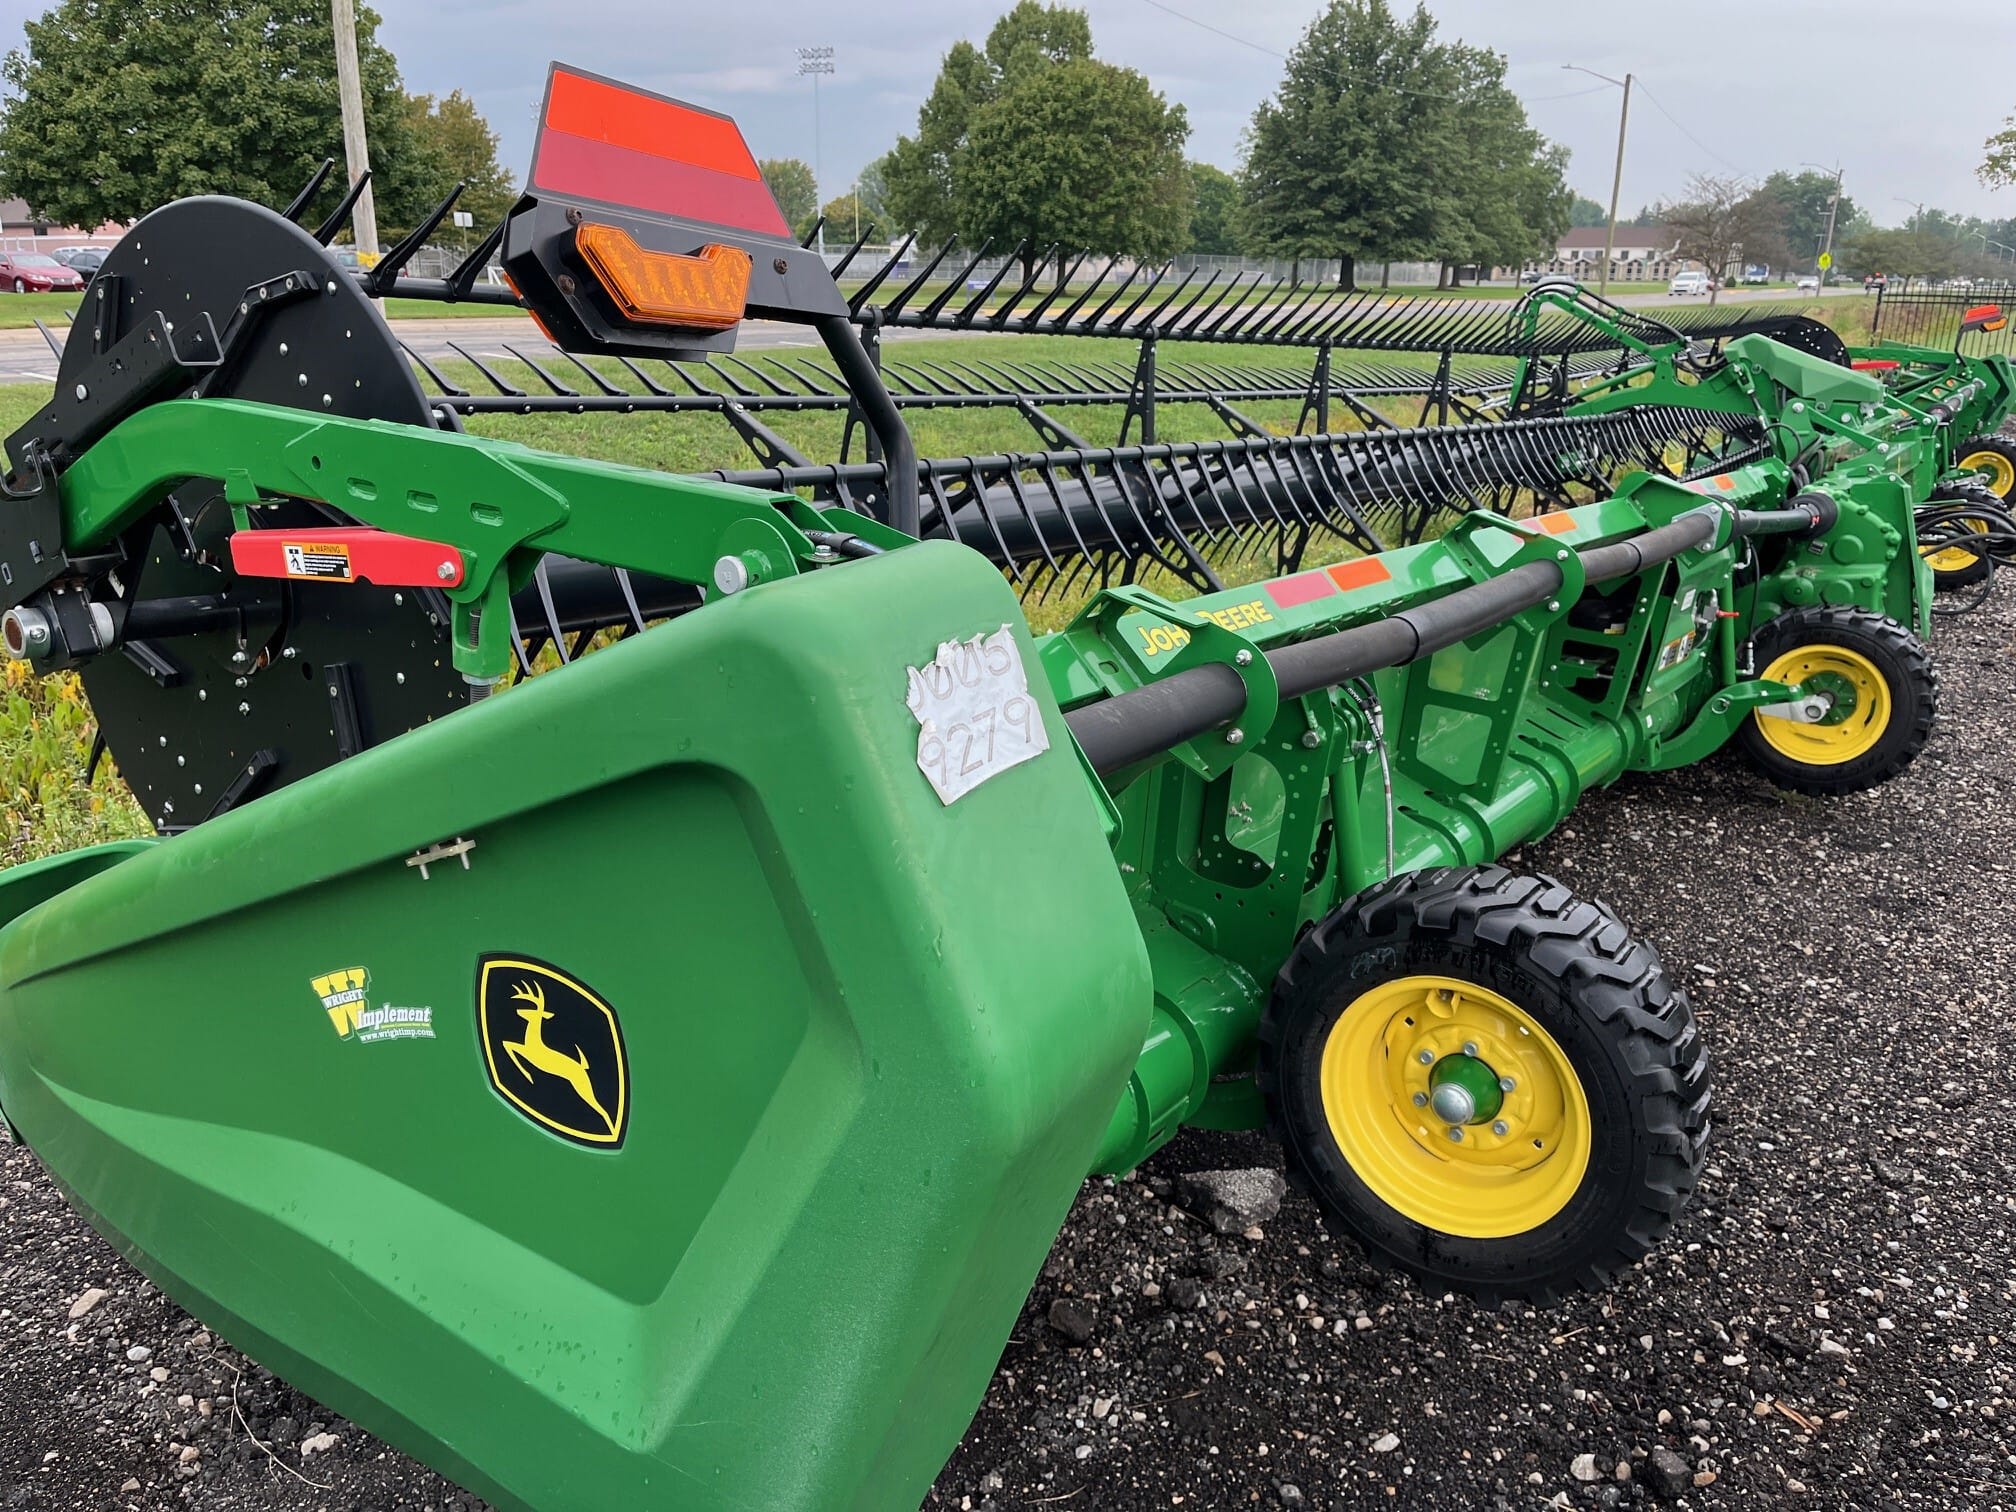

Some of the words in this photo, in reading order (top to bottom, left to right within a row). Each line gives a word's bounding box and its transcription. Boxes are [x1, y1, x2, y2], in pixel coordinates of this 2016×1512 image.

[1137, 624, 1191, 656] JOH
[919, 697, 1031, 787] 9279
[323, 989, 364, 1008] WRIGHT
[360, 1028, 434, 1041] www.wrightimp.com
